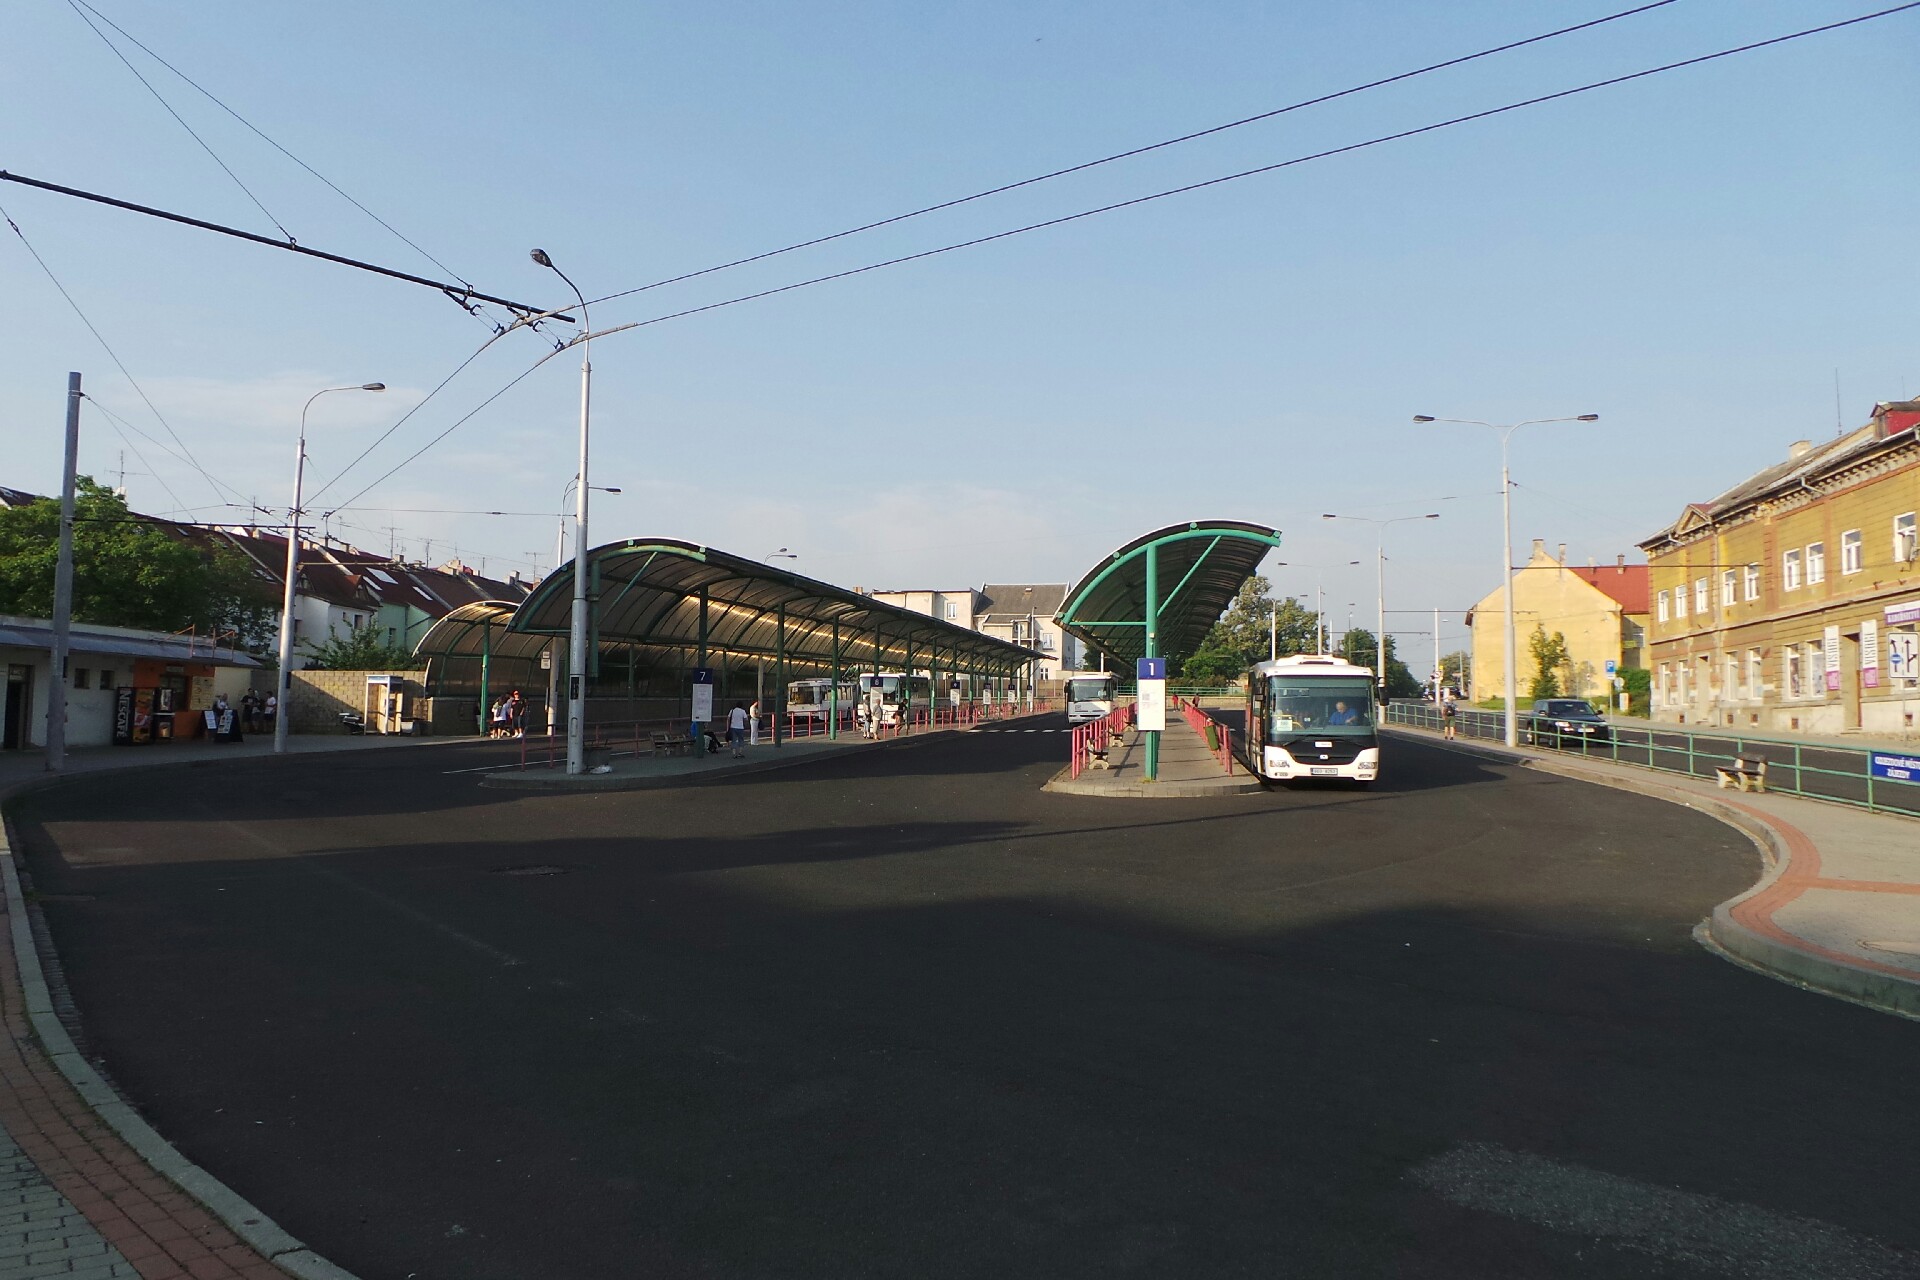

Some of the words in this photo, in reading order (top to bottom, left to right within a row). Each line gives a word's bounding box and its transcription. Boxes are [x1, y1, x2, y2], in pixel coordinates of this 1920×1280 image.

[1827, 637, 1838, 668] VISAGE
[1864, 632, 1876, 665] VISAGE
[699, 671, 706, 681] 7
[1148, 662, 1155, 676] 1
[117, 688, 132, 738] NESCAFÉ
